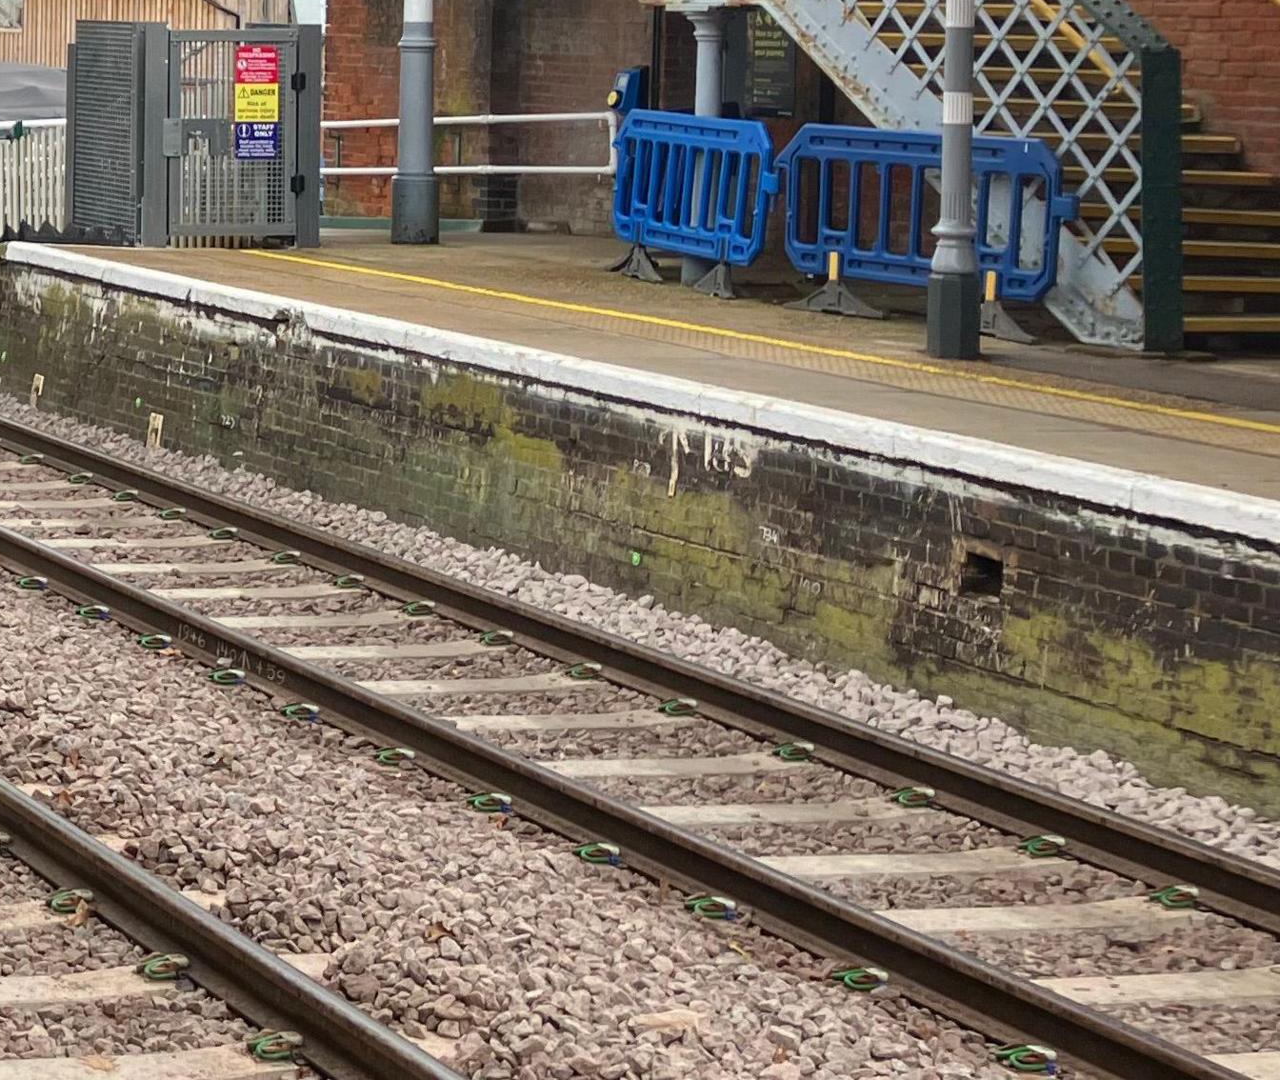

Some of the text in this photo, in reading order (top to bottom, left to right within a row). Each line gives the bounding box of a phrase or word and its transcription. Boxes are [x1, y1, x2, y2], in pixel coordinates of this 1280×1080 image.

[250, 88, 276, 96] DANGER
[252, 123, 275, 131] STAFF
[254, 130, 274, 138] ONLY
